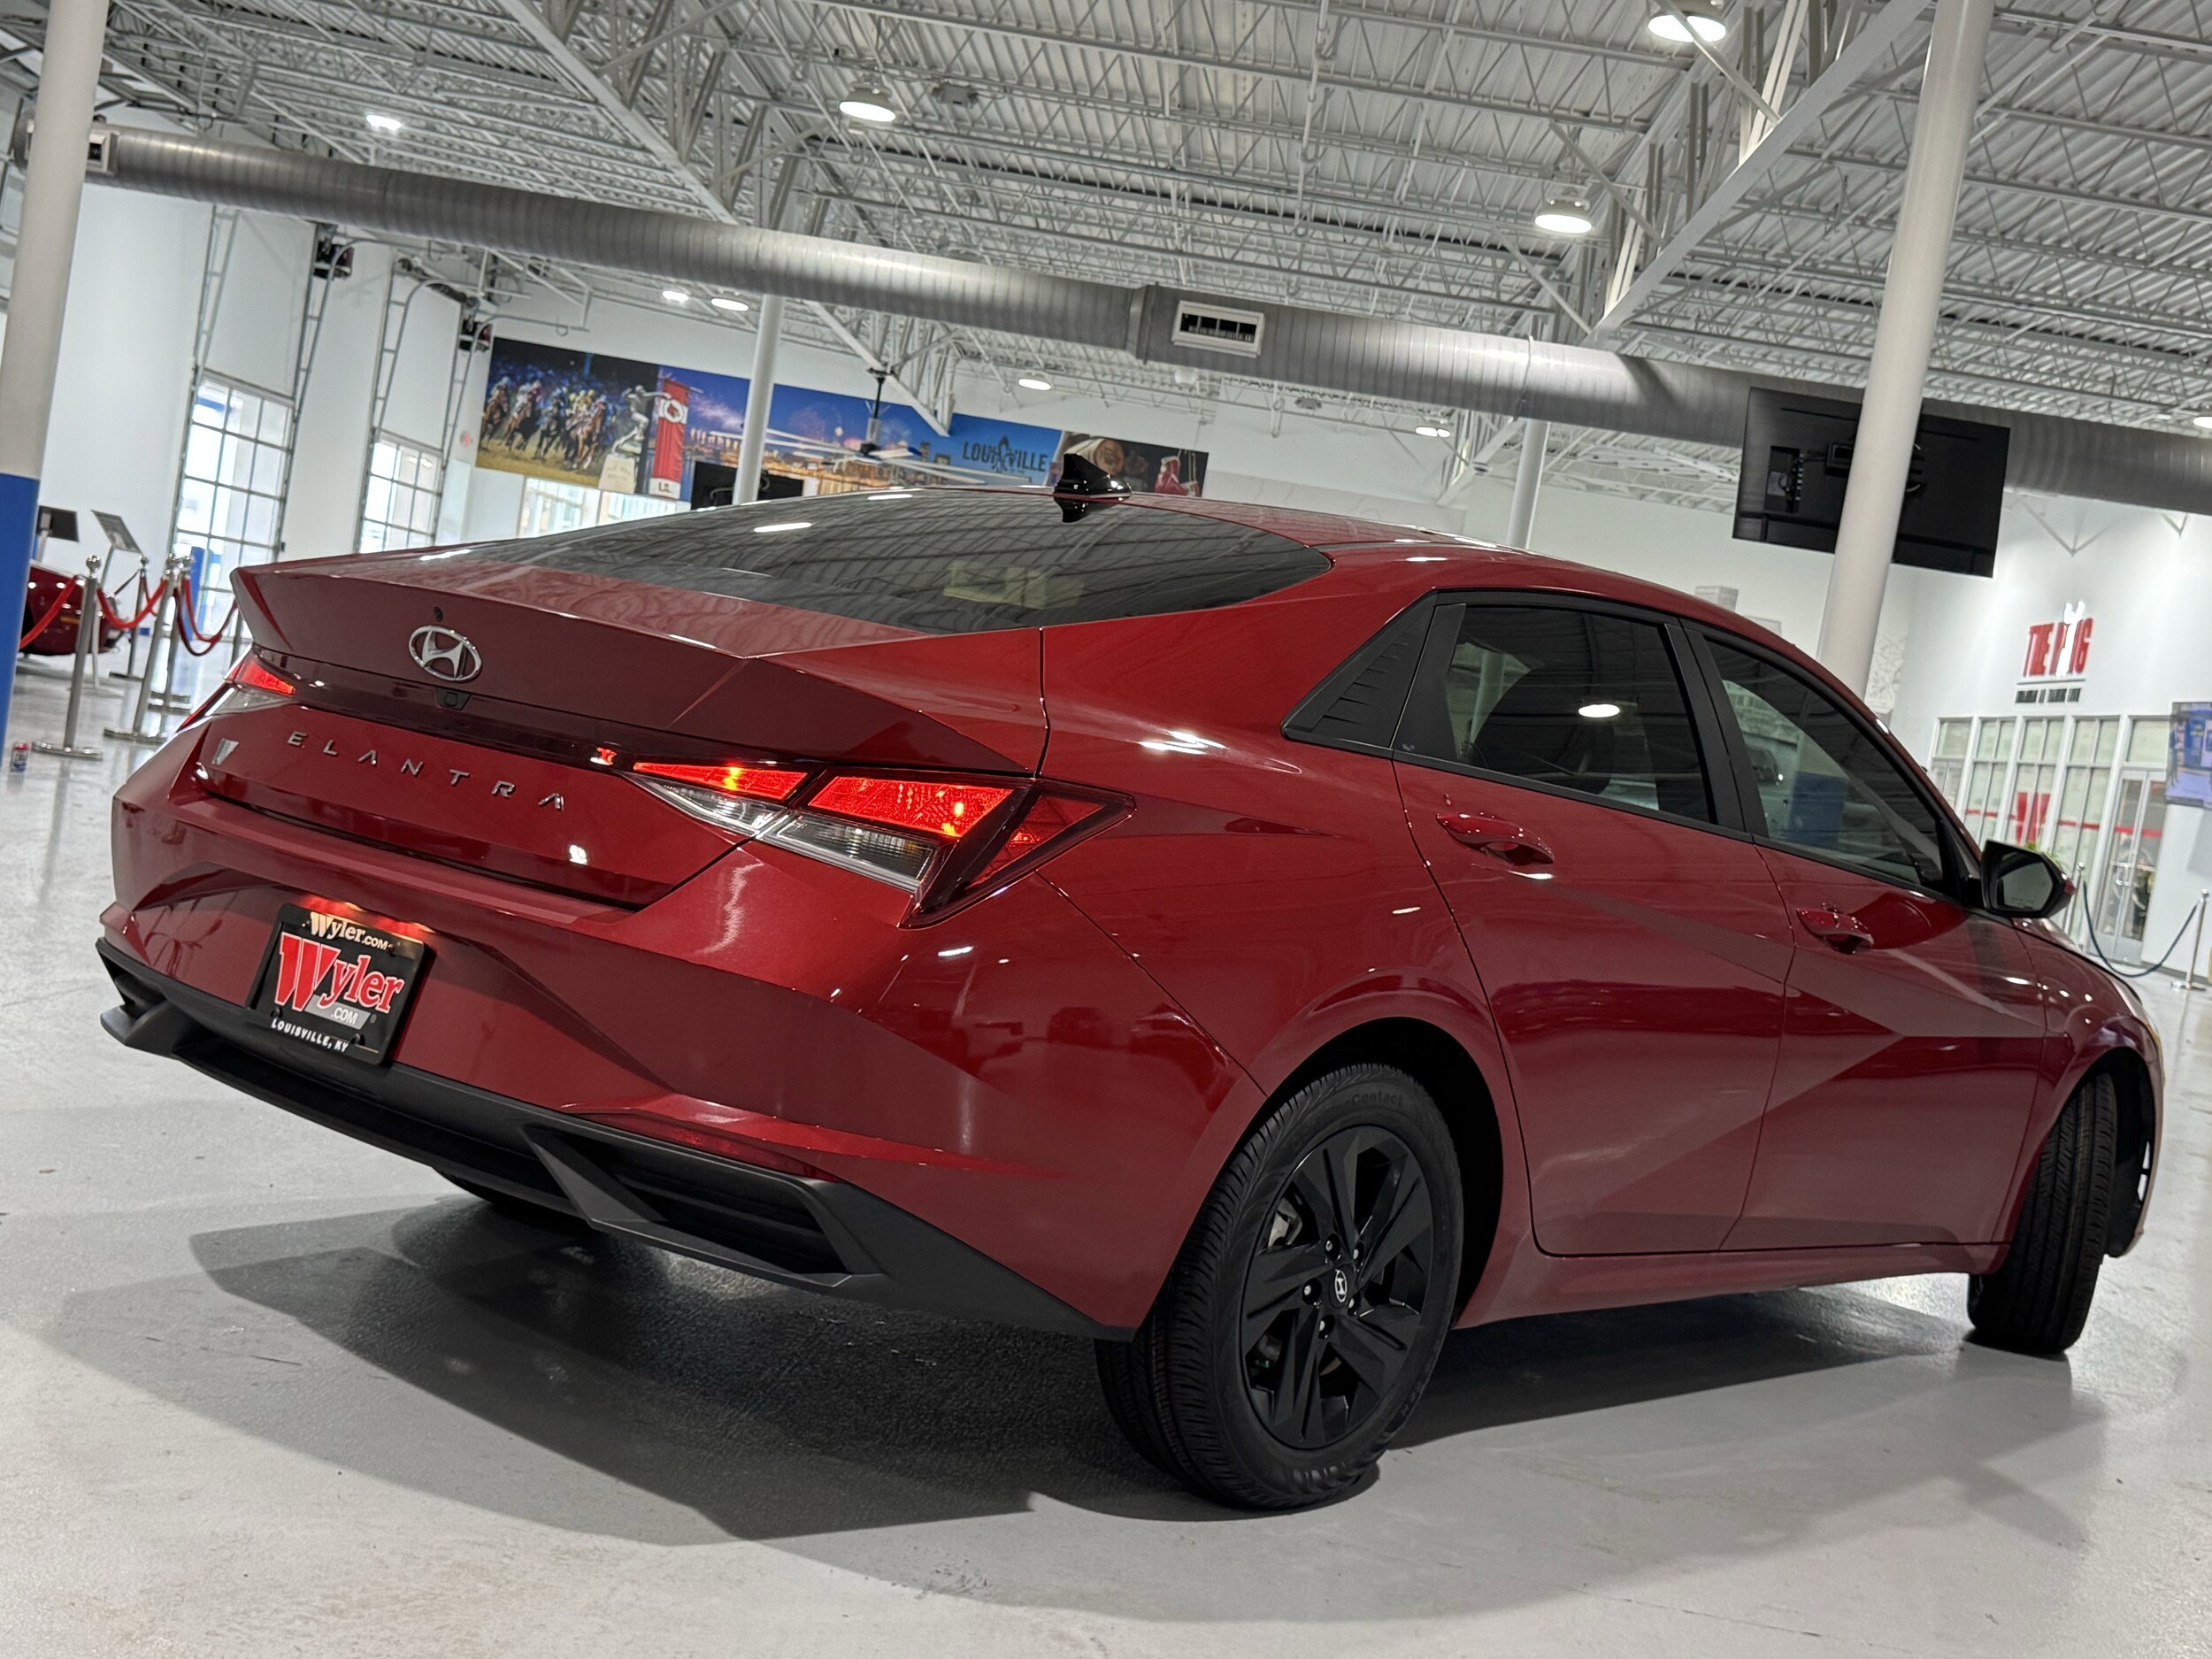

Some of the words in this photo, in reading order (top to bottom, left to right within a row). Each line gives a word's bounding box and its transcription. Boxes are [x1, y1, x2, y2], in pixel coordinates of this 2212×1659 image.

[963, 441, 1048, 472] LOUIVILLE
[287, 730, 565, 812] ELANTRA
[275, 933, 404, 1013] Wyler
[331, 1007, 358, 1025] .COM
[271, 1018, 333, 1048] LOUISVILLE,
[334, 1040, 349, 1053] KY
